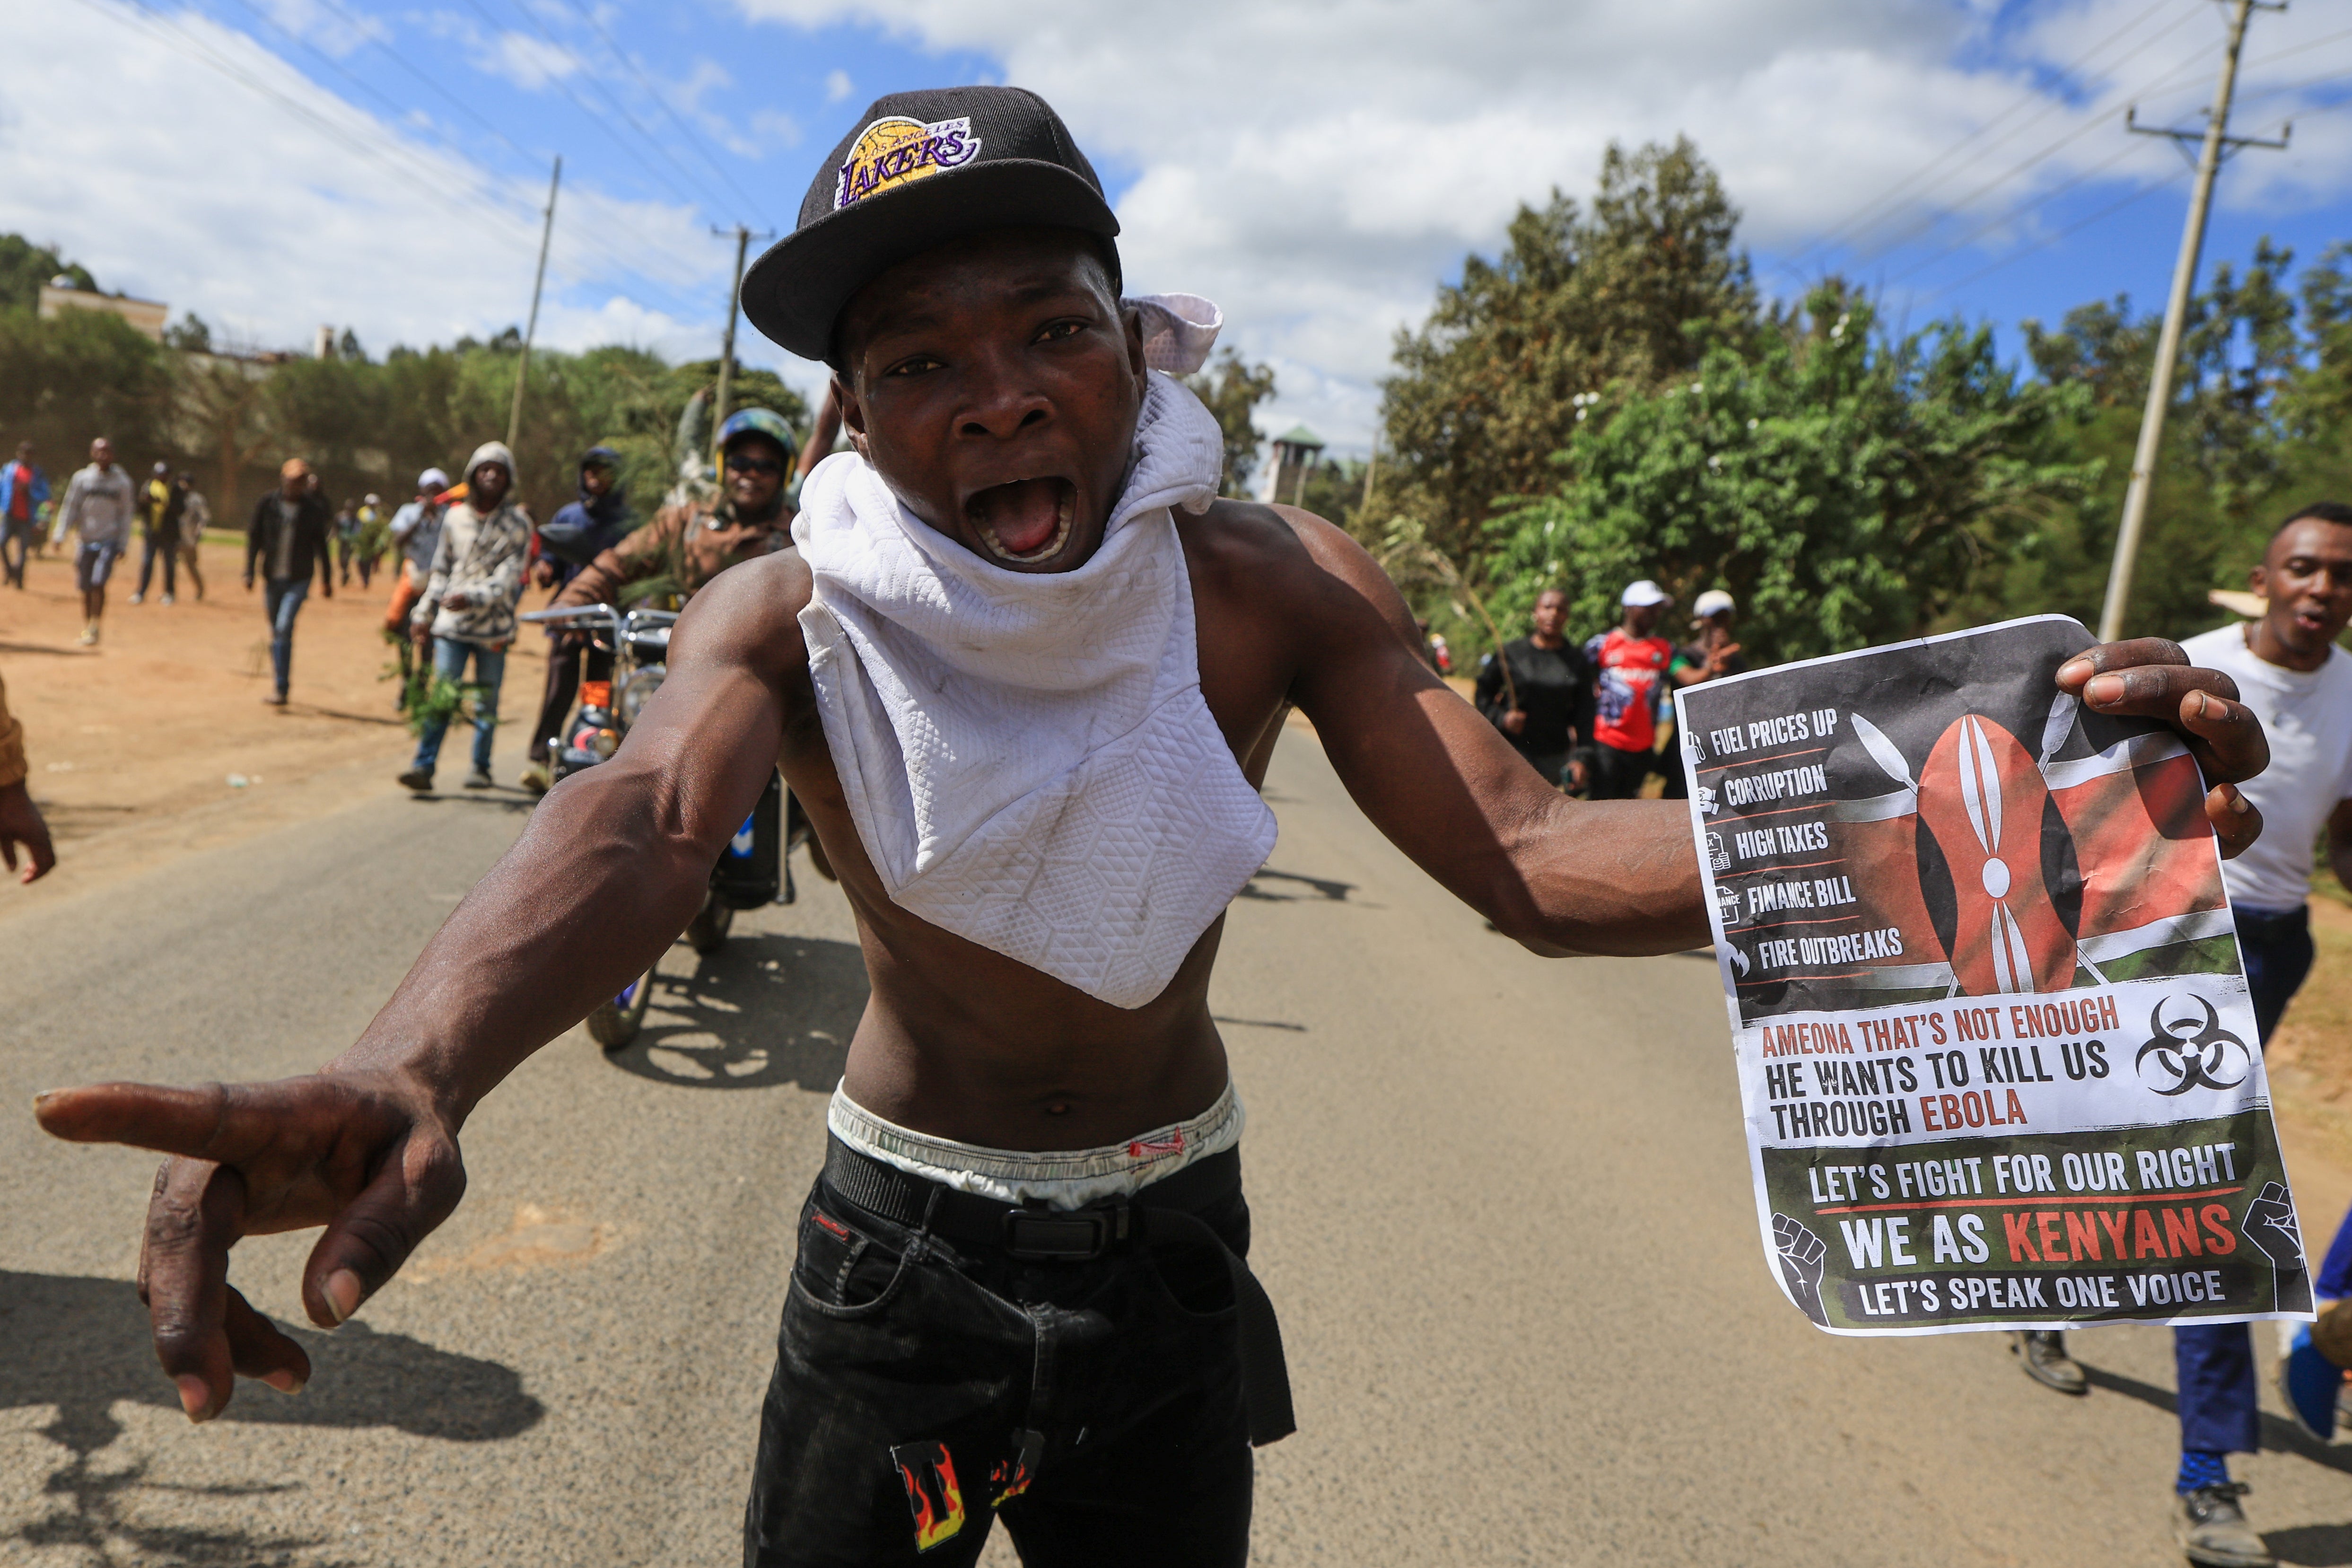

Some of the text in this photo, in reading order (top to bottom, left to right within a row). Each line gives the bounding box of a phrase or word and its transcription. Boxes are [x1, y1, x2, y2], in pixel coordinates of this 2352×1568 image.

[892, 121, 964, 147] ANGELES
[838, 130, 977, 207] LAKERS
[1710, 708, 1837, 756] FUEL PRICES UP
[1724, 764, 1828, 806] CORRUPTION
[1735, 821, 1828, 859] HIGH TAXES
[1747, 876, 1856, 914] FINANCE BILL
[1758, 928, 1903, 969] FIRE OUTBREAKS
[1763, 995, 2120, 1058] AMEONA THAT'S NOT ENOUGH
[1766, 1040, 2109, 1100] HE WANTS TO KILL US
[1770, 1088, 2028, 1140] THROUGH EBOLA
[1809, 1142, 2236, 1203] LET'S FIGHT FOR OUR RIGHT
[1839, 1203, 2237, 1270] WE AS KENYANS
[1858, 1270, 2226, 1315] LET'S SPEAK ONE VOICE
